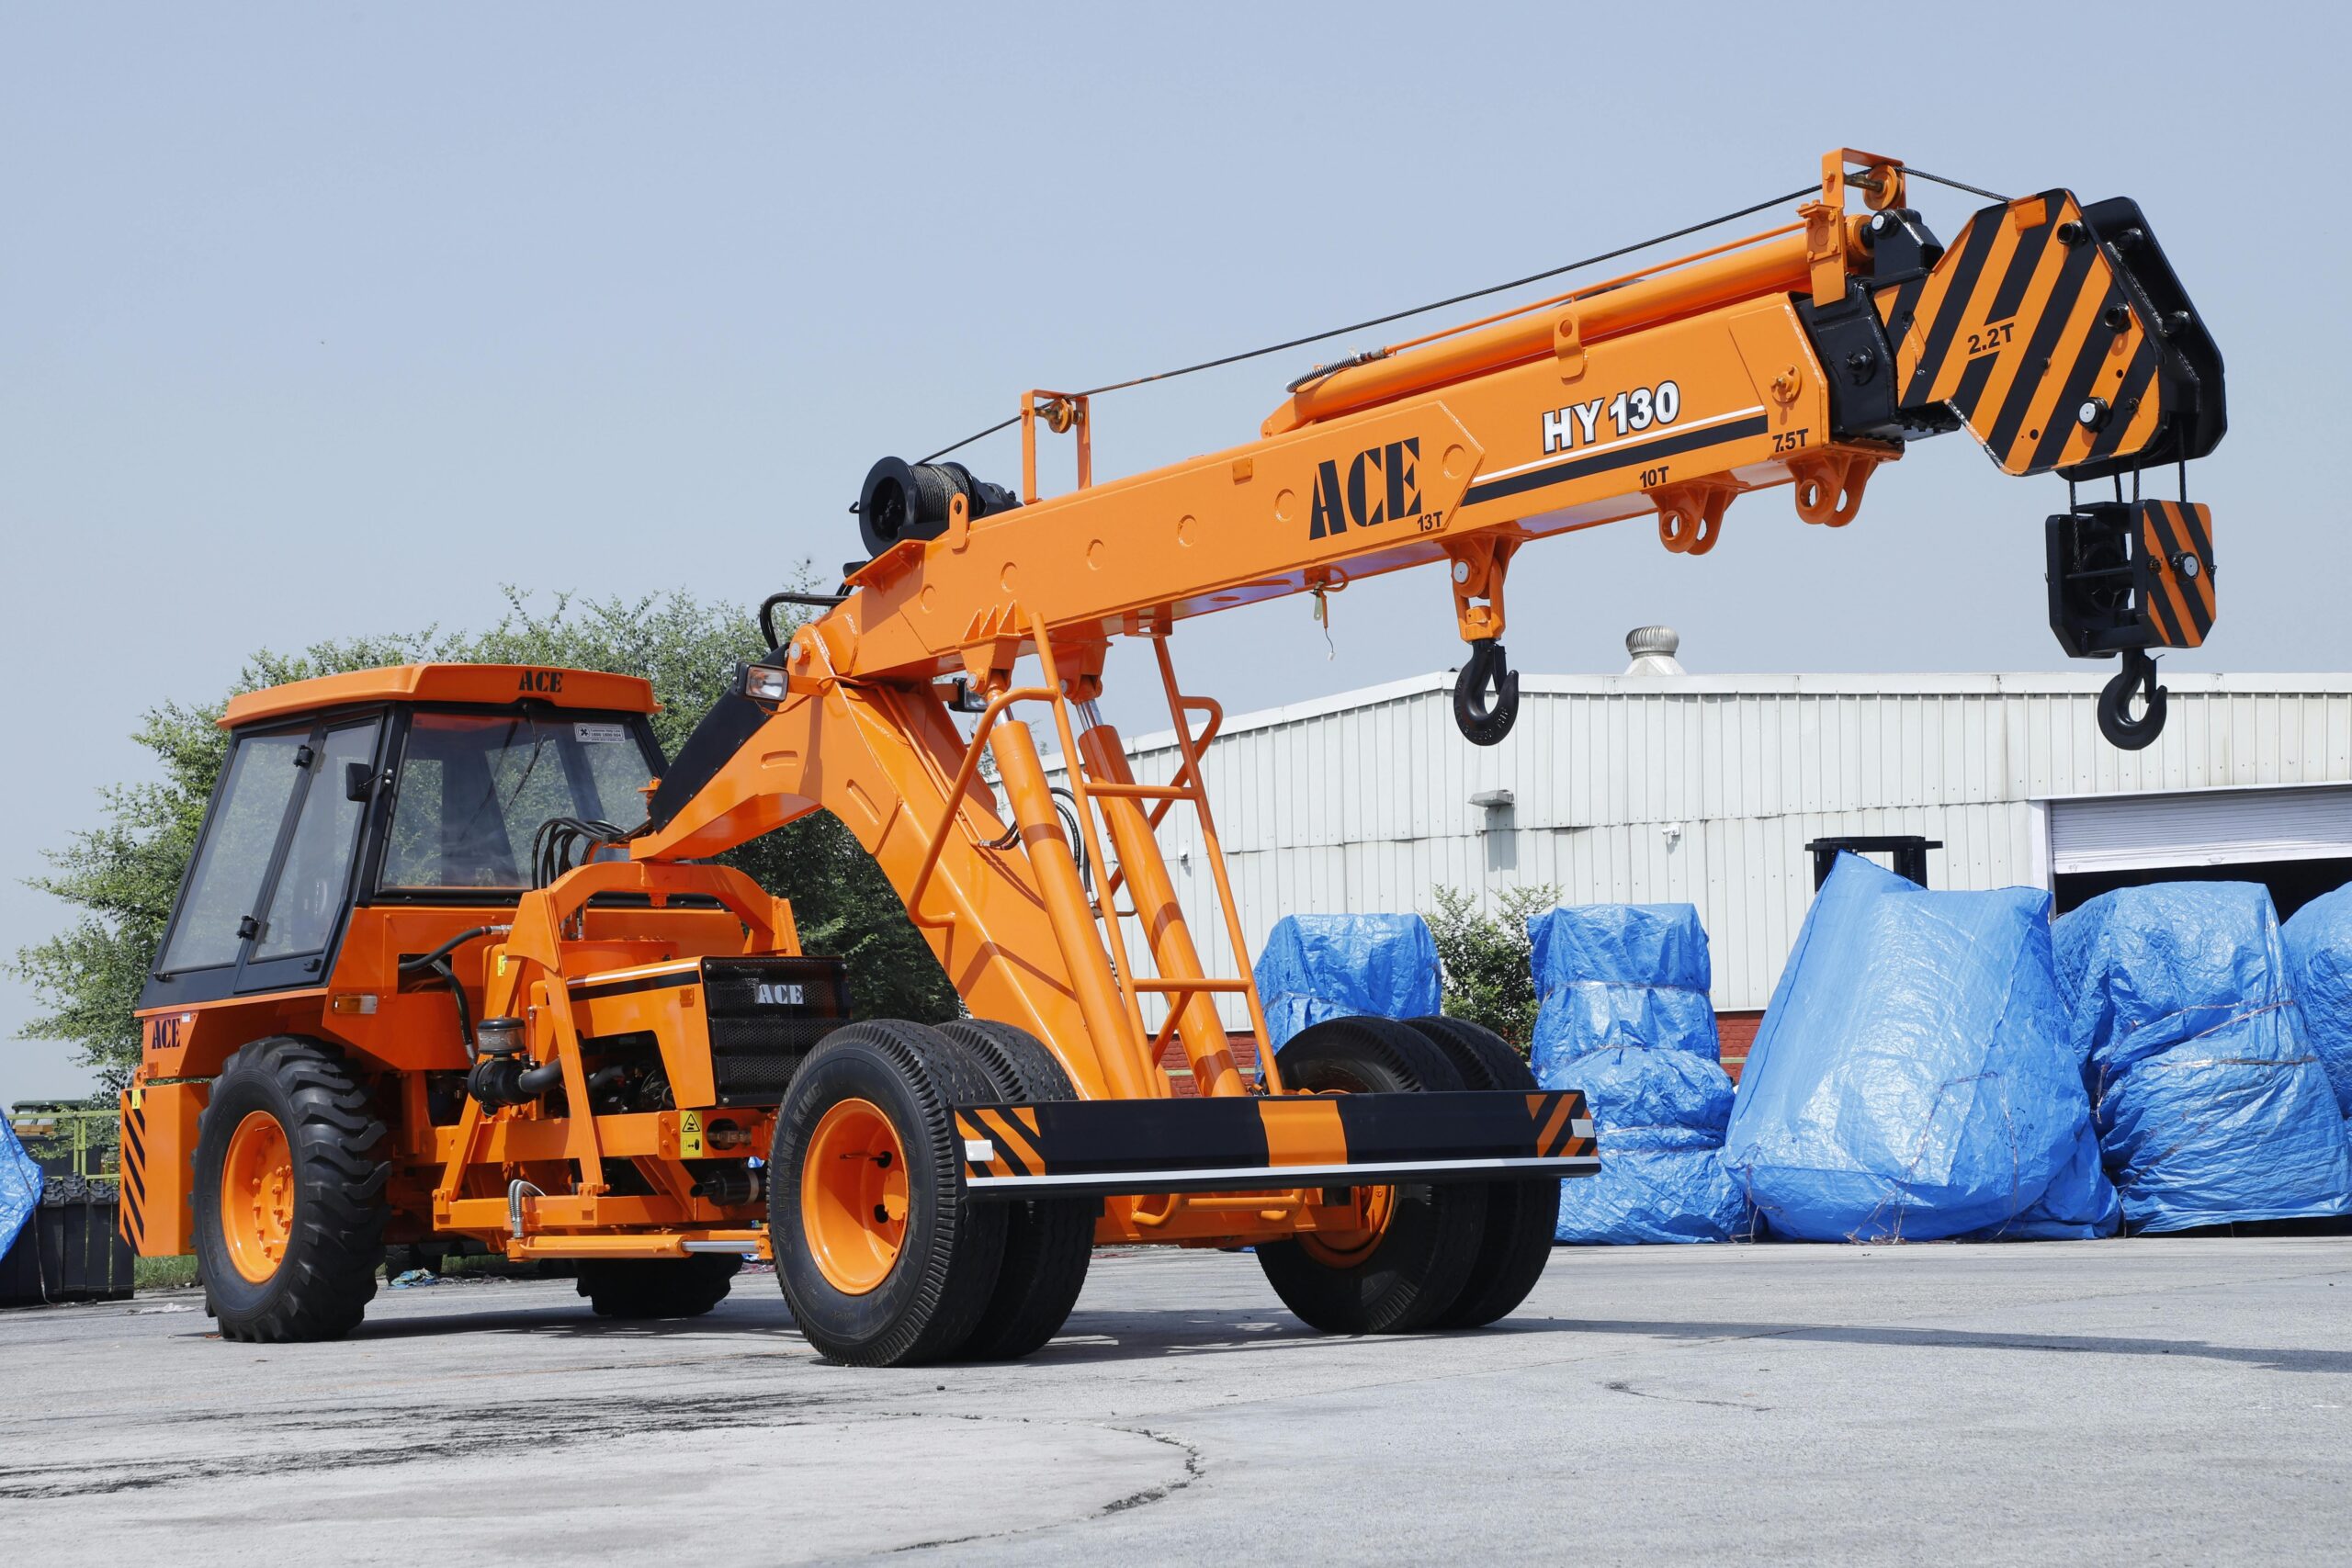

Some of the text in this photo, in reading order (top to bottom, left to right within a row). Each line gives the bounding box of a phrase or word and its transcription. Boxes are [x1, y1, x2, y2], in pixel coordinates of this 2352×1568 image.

[1967, 321, 2015, 355] 2.2T
[1542, 379, 1680, 456] HY 130
[1771, 428, 1809, 453] 7.5T
[1309, 436, 1422, 541] ACE
[1639, 466, 1669, 488] 10T
[1417, 511, 1443, 532] 13T
[518, 670, 563, 693] ACE
[757, 984, 805, 1005] ACE
[152, 1018, 181, 1050] ACE
